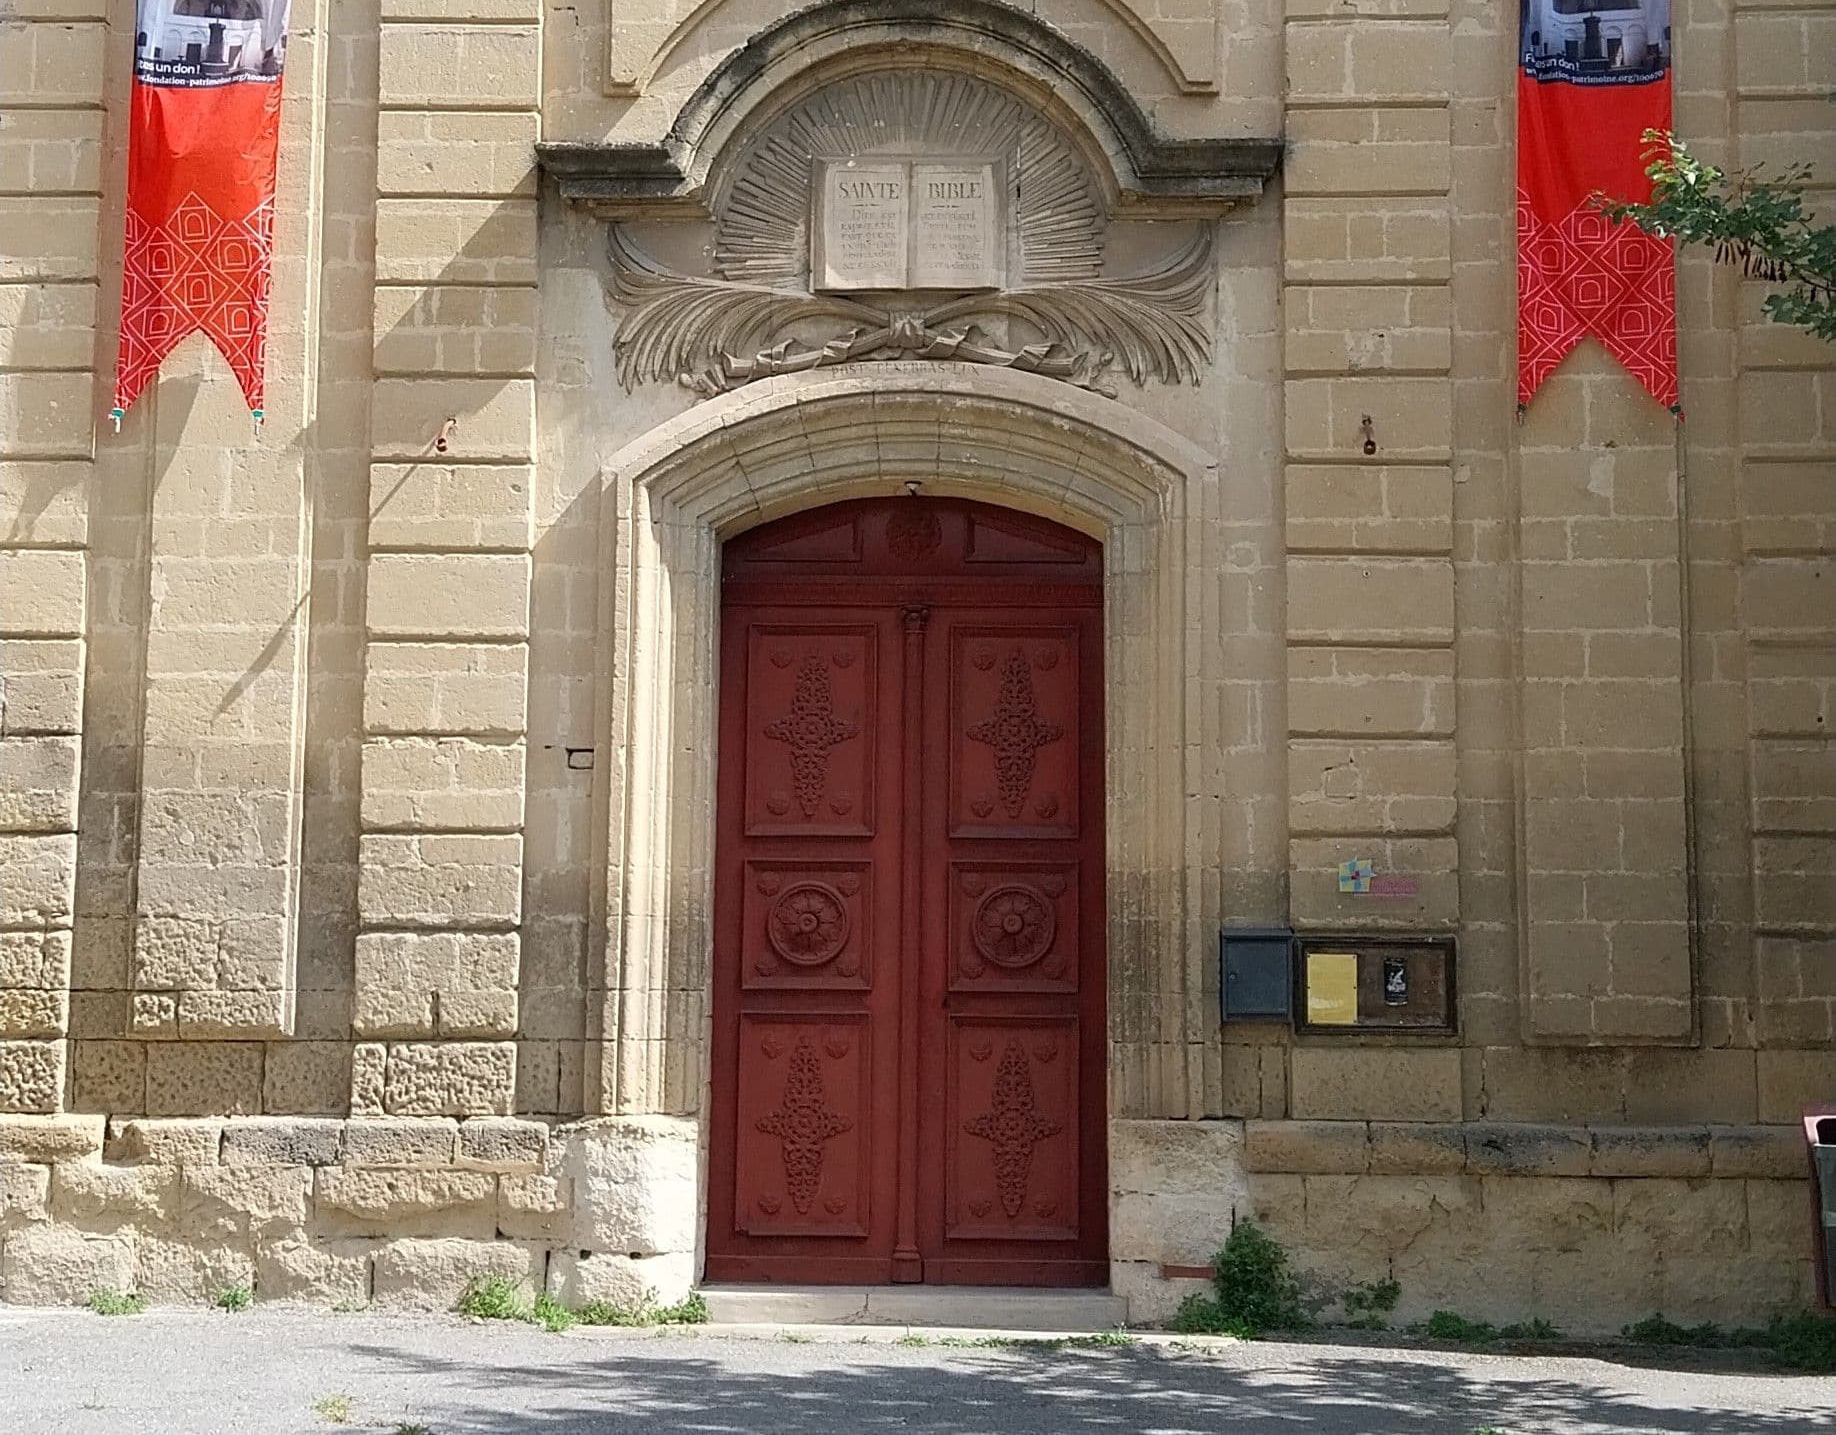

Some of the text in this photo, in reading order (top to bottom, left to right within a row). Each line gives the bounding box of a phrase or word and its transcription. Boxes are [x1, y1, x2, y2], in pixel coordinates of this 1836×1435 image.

[156, 64, 171, 73] un
[173, 63, 195, 74] don
[838, 182, 982, 199] SAINTE BIBLE
